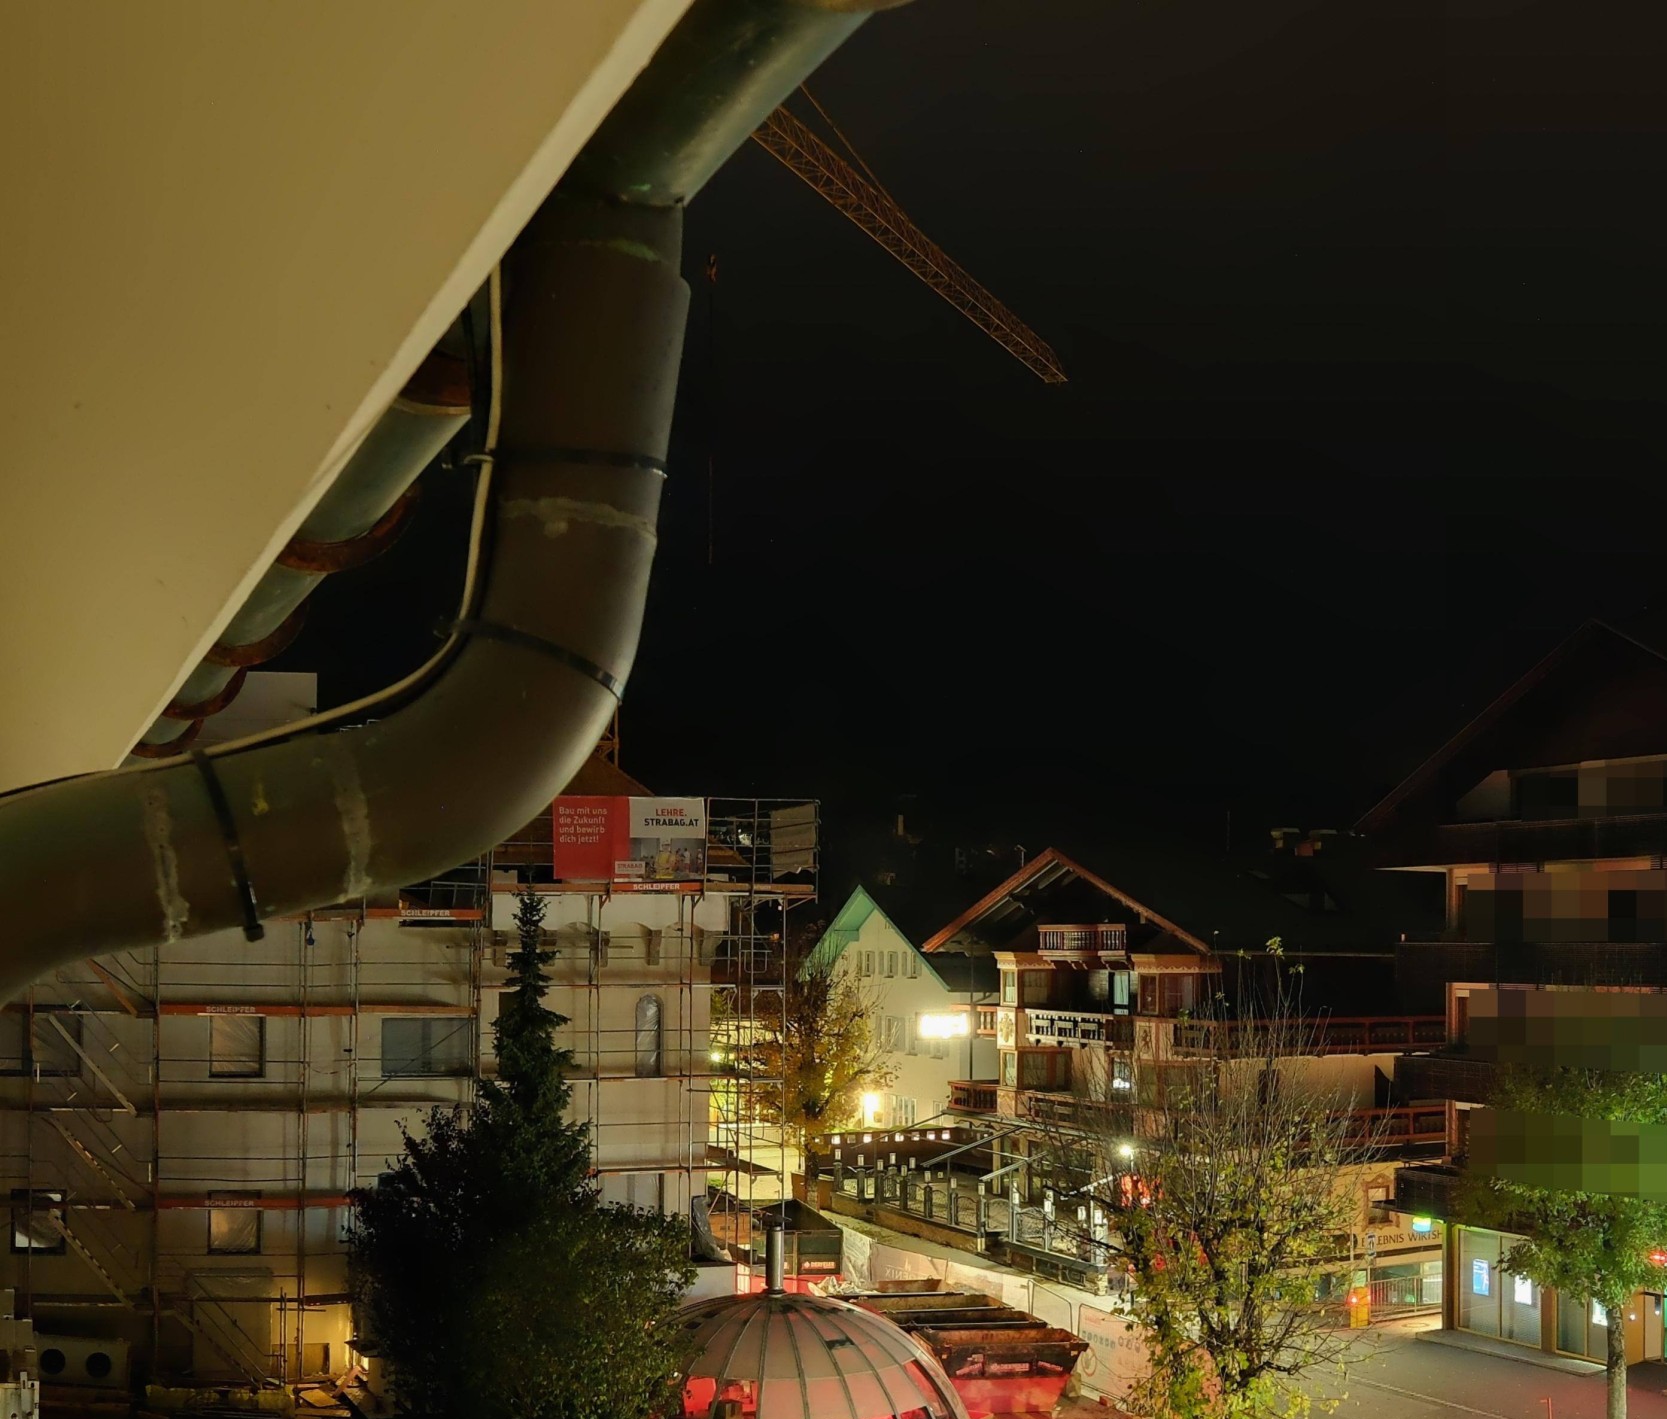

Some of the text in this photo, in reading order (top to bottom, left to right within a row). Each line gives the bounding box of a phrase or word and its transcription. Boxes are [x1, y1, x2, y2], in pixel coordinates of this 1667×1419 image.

[559, 806, 608, 815] Bau mit uns
[655, 808, 687, 817] LEHRE.
[559, 816, 572, 824] die
[644, 817, 699, 827] STRABAG.AT
[559, 825, 574, 834] und
[559, 834, 599, 844] dich jetzt!
[633, 883, 680, 891] SCHLEIPFER
[401, 909, 450, 917] SCHLEIPFER
[205, 1006, 256, 1014] SCHLEIPFER
[204, 1199, 255, 1208] SCHLEIPFER
[1361, 1233, 1405, 1247] ELEBNIS
